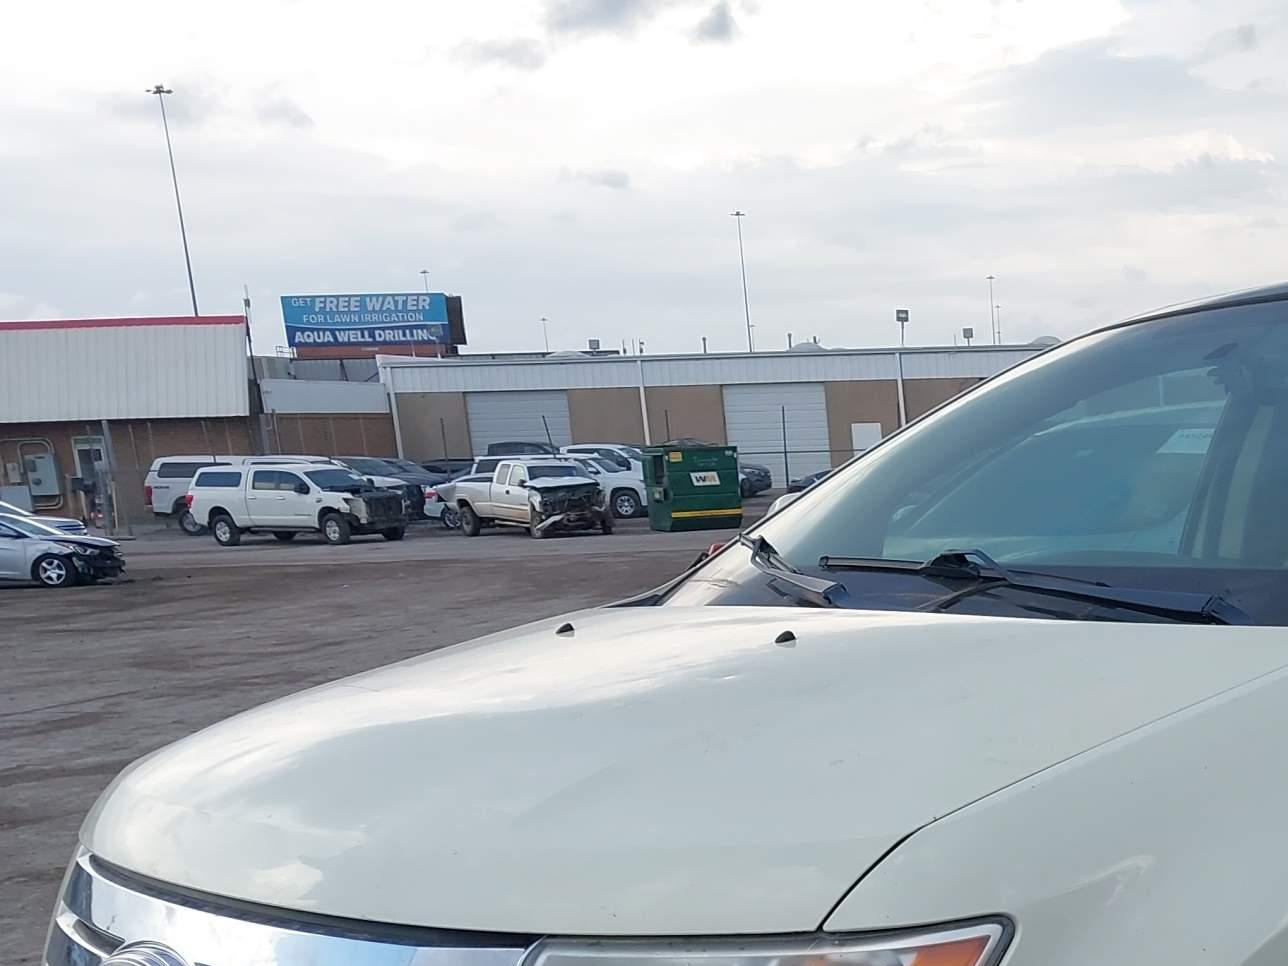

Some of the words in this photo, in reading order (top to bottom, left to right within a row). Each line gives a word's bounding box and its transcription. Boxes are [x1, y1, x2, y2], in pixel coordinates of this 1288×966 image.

[291, 297, 311, 307] GET
[314, 296, 361, 312] FREE
[366, 295, 430, 311] WATER
[303, 314, 324, 324] FOR
[327, 313, 359, 323] LAWN
[361, 312, 424, 323] IRRIGATION
[294, 331, 334, 343] AQUA
[335, 330, 372, 343] WELL
